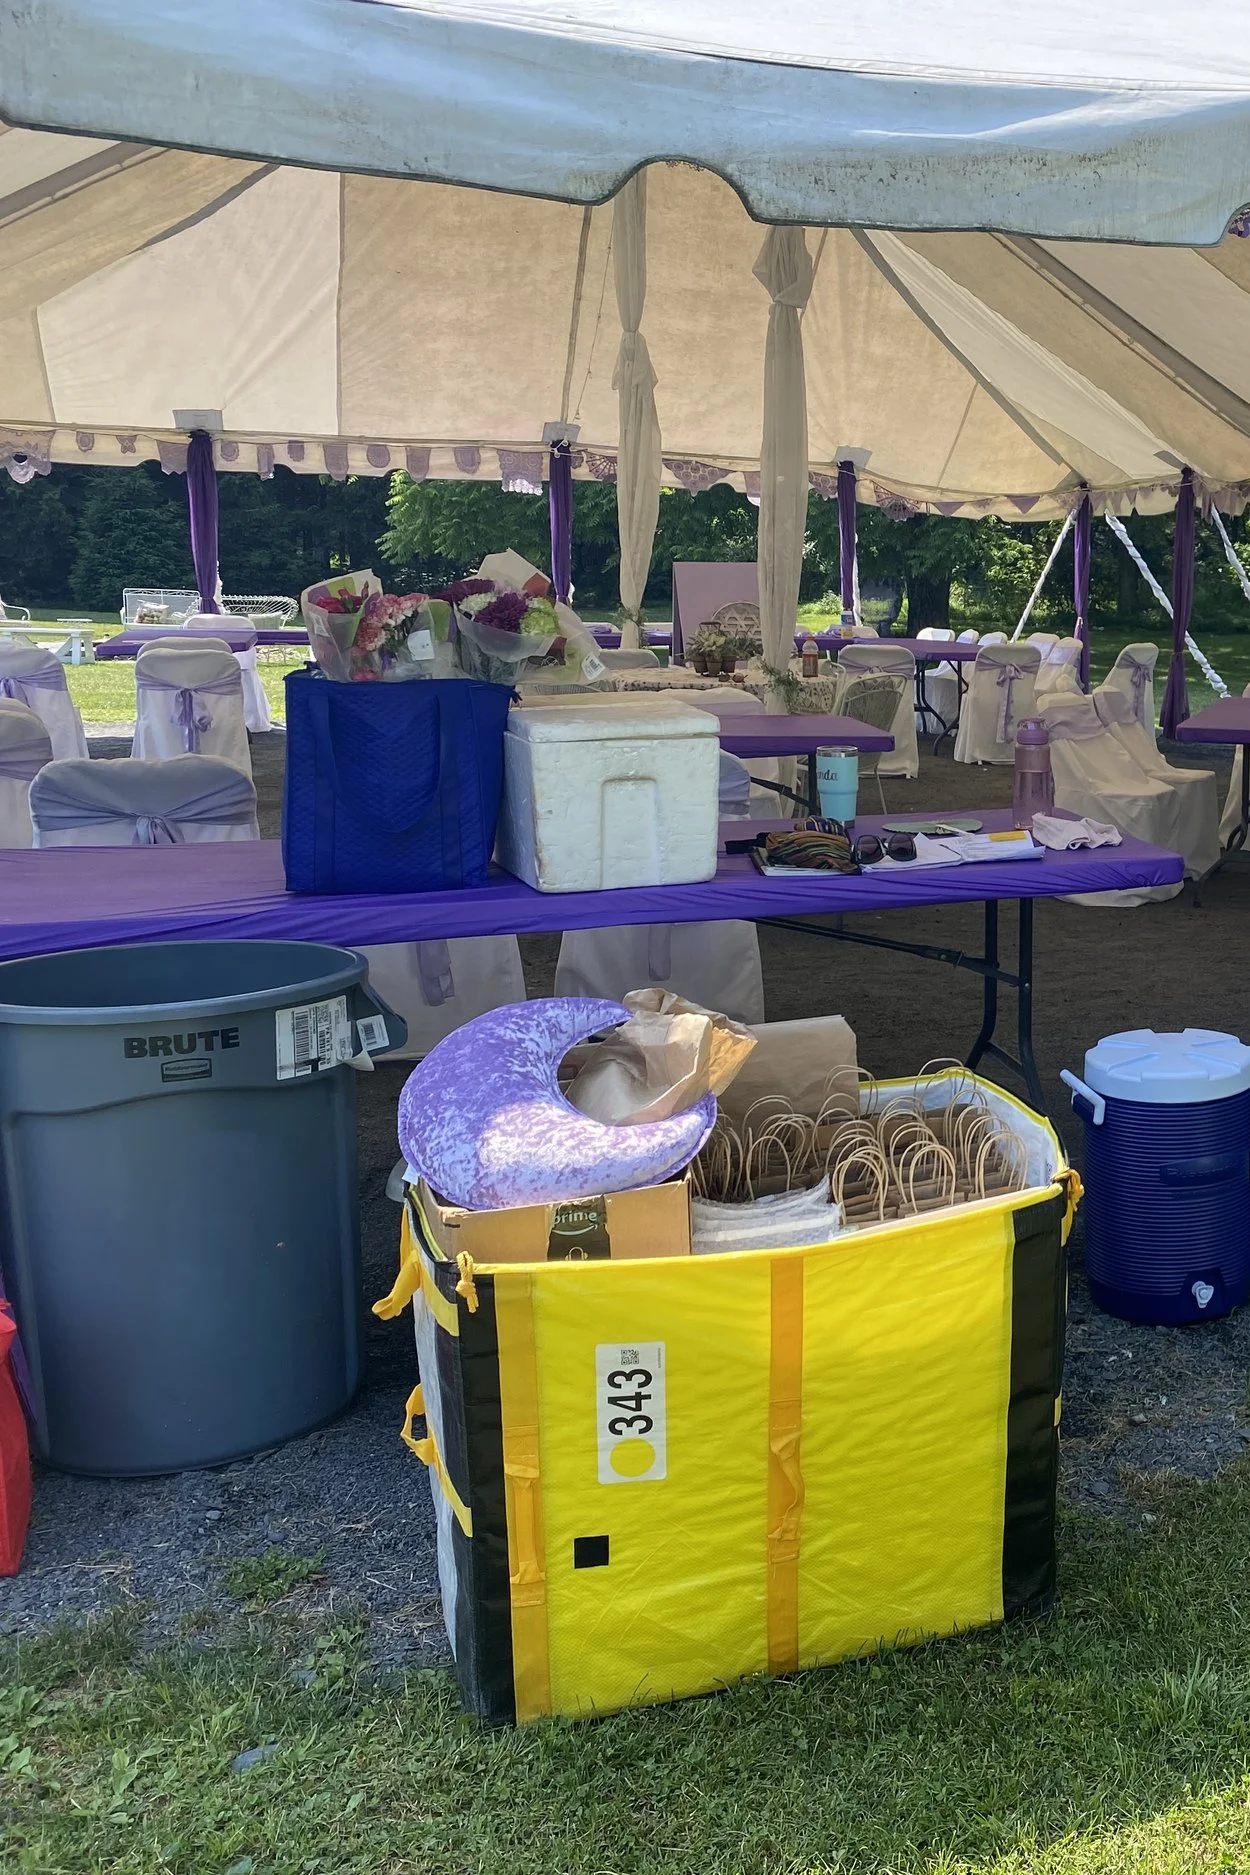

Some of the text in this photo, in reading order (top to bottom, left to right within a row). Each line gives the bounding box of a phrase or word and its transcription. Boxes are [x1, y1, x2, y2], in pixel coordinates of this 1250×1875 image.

[124, 1027, 240, 1058] BRUTE
[553, 1209, 598, 1226] prime
[607, 1368, 654, 1436] 343
